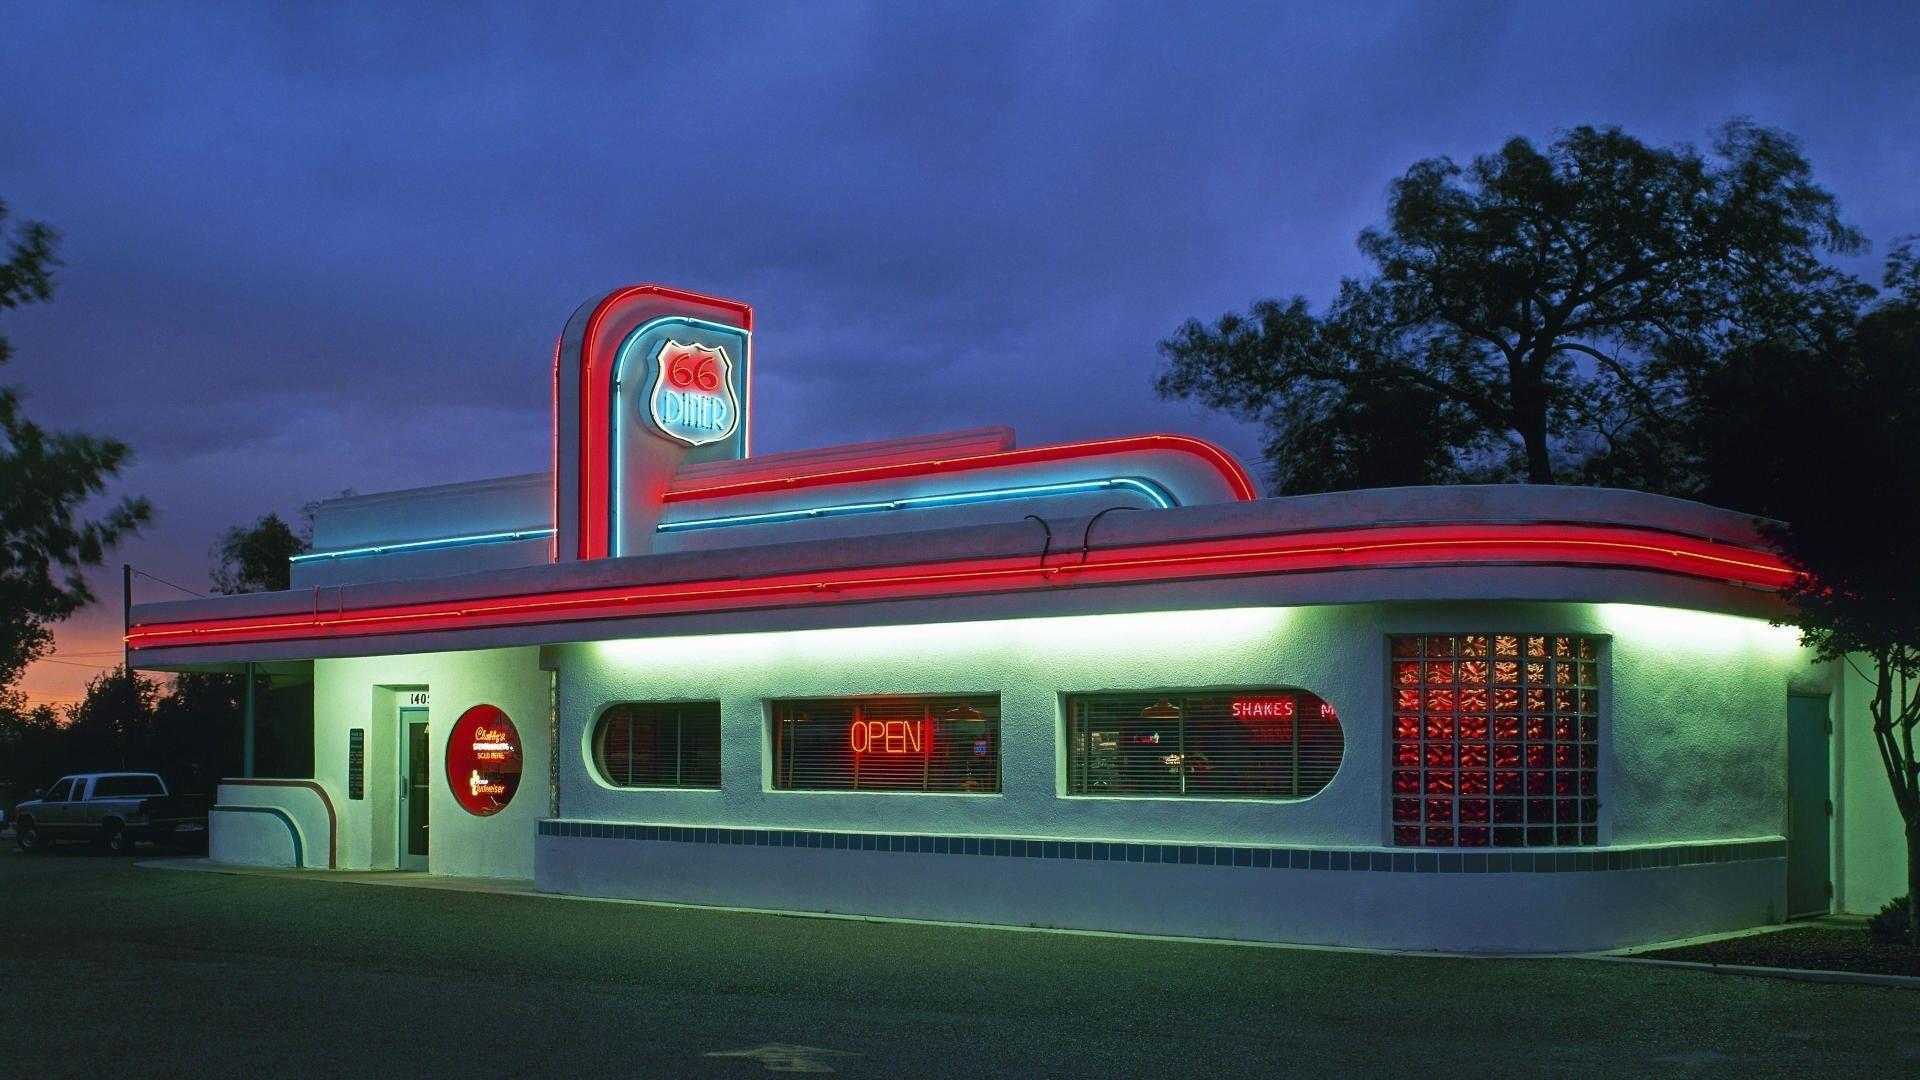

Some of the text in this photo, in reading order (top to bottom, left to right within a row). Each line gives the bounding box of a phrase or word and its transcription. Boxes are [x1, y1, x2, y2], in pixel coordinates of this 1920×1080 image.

[668, 353, 719, 391] 66
[662, 391, 727, 430] DINER
[1232, 702, 1293, 716] SHAKES
[851, 720, 920, 753] OPEN
